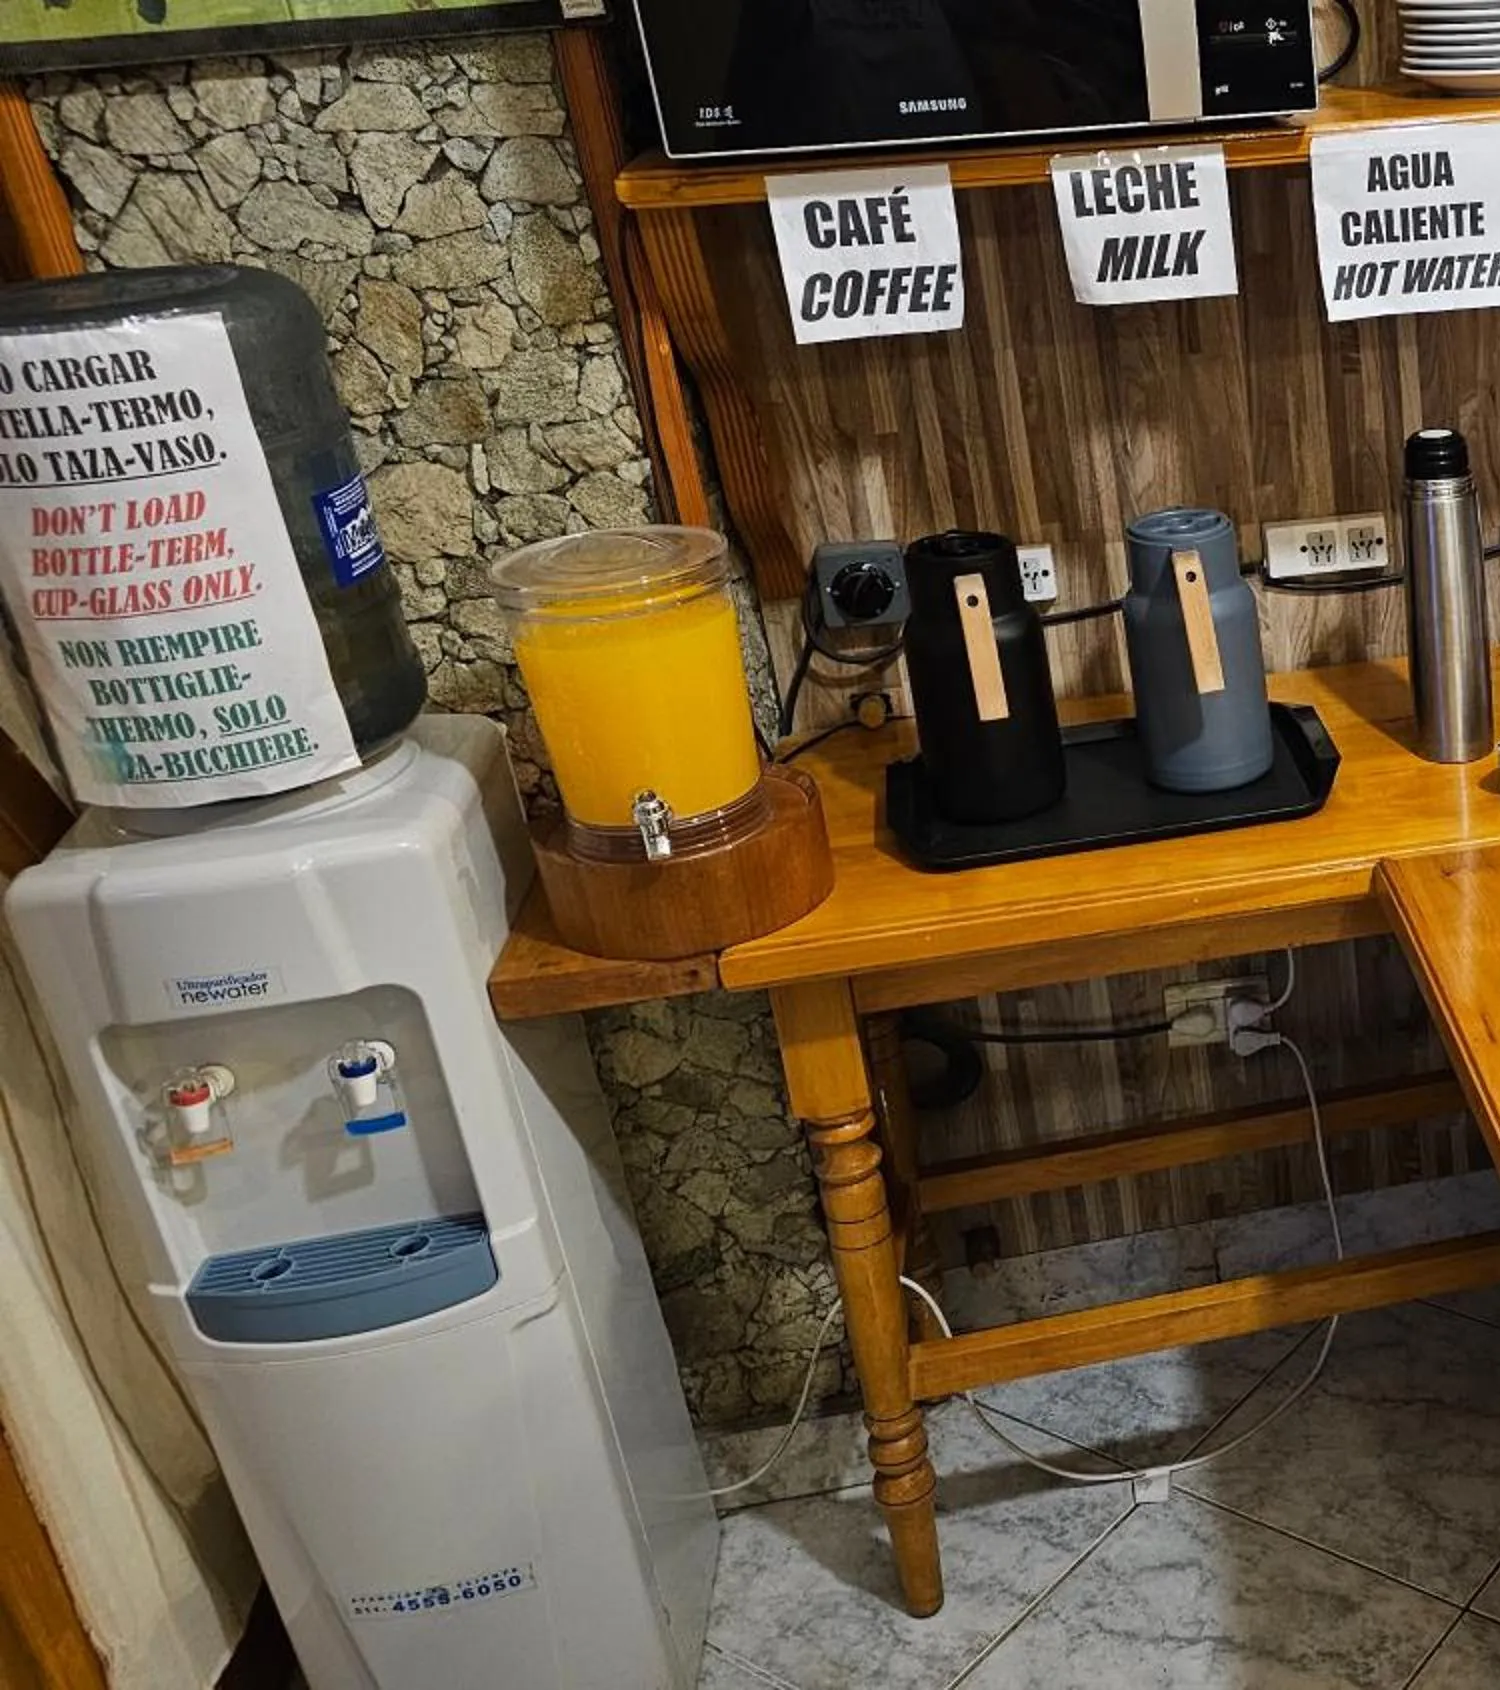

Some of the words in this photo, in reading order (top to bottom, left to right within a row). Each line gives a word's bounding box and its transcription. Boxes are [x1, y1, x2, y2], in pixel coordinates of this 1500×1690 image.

[899, 97, 967, 114] SAMSUNG
[1069, 161, 1201, 219] LECHE
[1366, 150, 1455, 193] AGUA
[802, 186, 916, 250] CAFÉ
[1340, 201, 1486, 247] CALIENTE
[1095, 229, 1207, 283] MILK
[1332, 259, 1400, 301] HOT
[799, 263, 958, 323] COFFEE
[0, 362, 14, 395] O
[22, 349, 157, 393] CARGAR
[0, 388, 215, 439] TELLA-TERMO,
[0, 452, 38, 483] LO
[43, 431, 228, 482] TAZA-VASO.
[31, 502, 116, 537] DON'T
[126, 489, 207, 530] LOAD
[31, 527, 235, 578] BOTTLE-TERM,
[32, 579, 173, 618] CUP-GLASS
[183, 562, 263, 605] ONLY.
[58, 638, 113, 669] NON
[114, 618, 263, 668] RIEMPIRE
[88, 663, 252, 707] BOTTIGLIE-
[212, 693, 288, 734] SOLO
[181, 981, 269, 1004] newater
